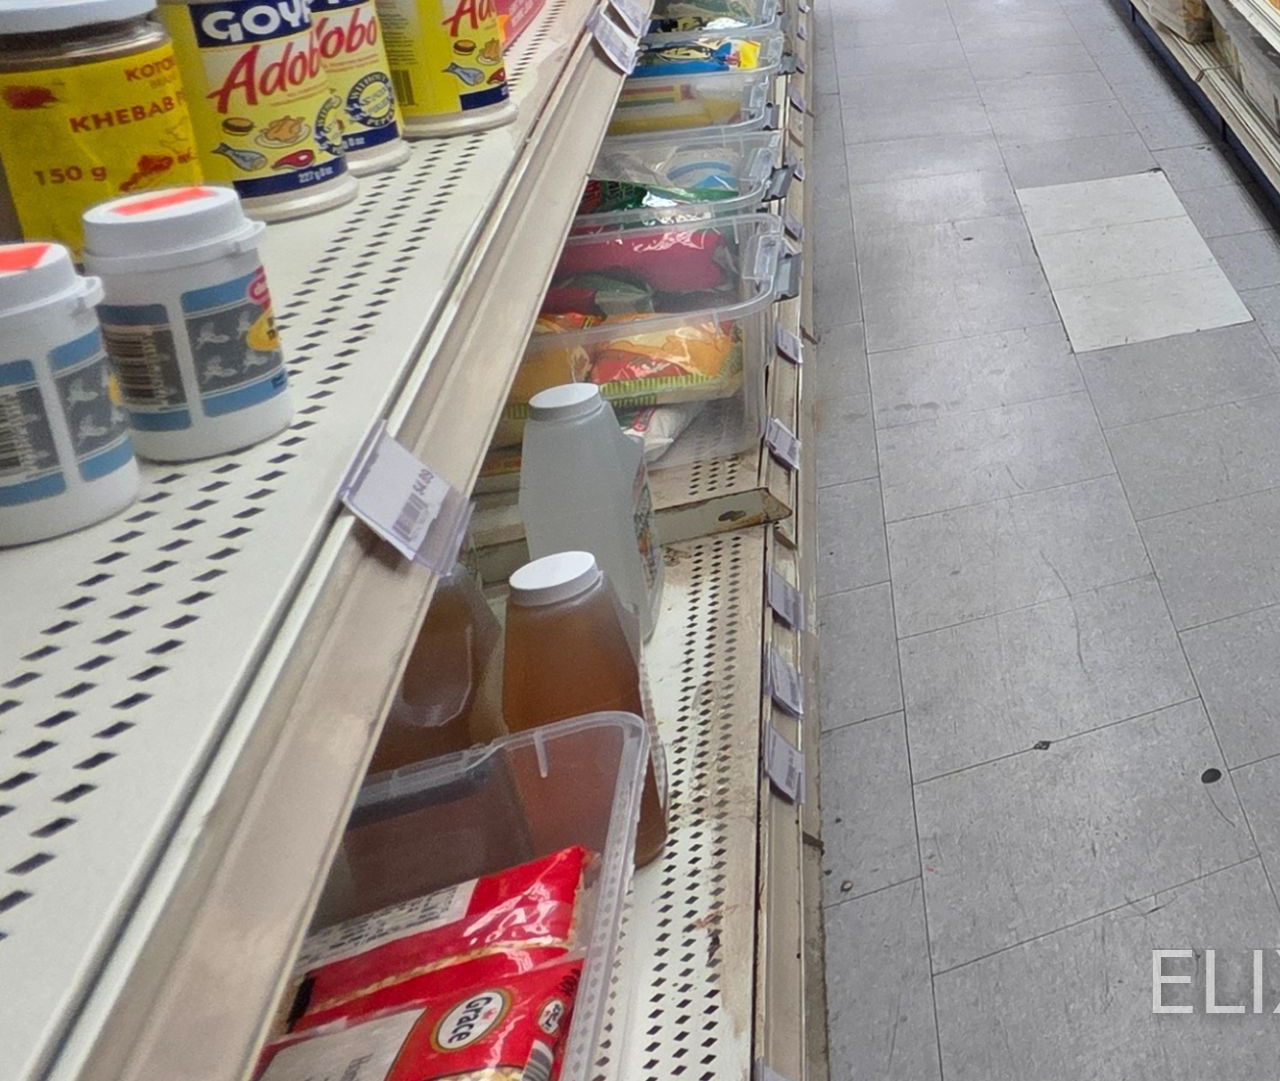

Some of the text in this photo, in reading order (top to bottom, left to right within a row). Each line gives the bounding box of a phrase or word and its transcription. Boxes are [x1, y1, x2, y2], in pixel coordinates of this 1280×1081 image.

[69, 95, 175, 133] KHEBAB
[34, 166, 107, 186] 150 g
[447, 996, 493, 1044] Grace
